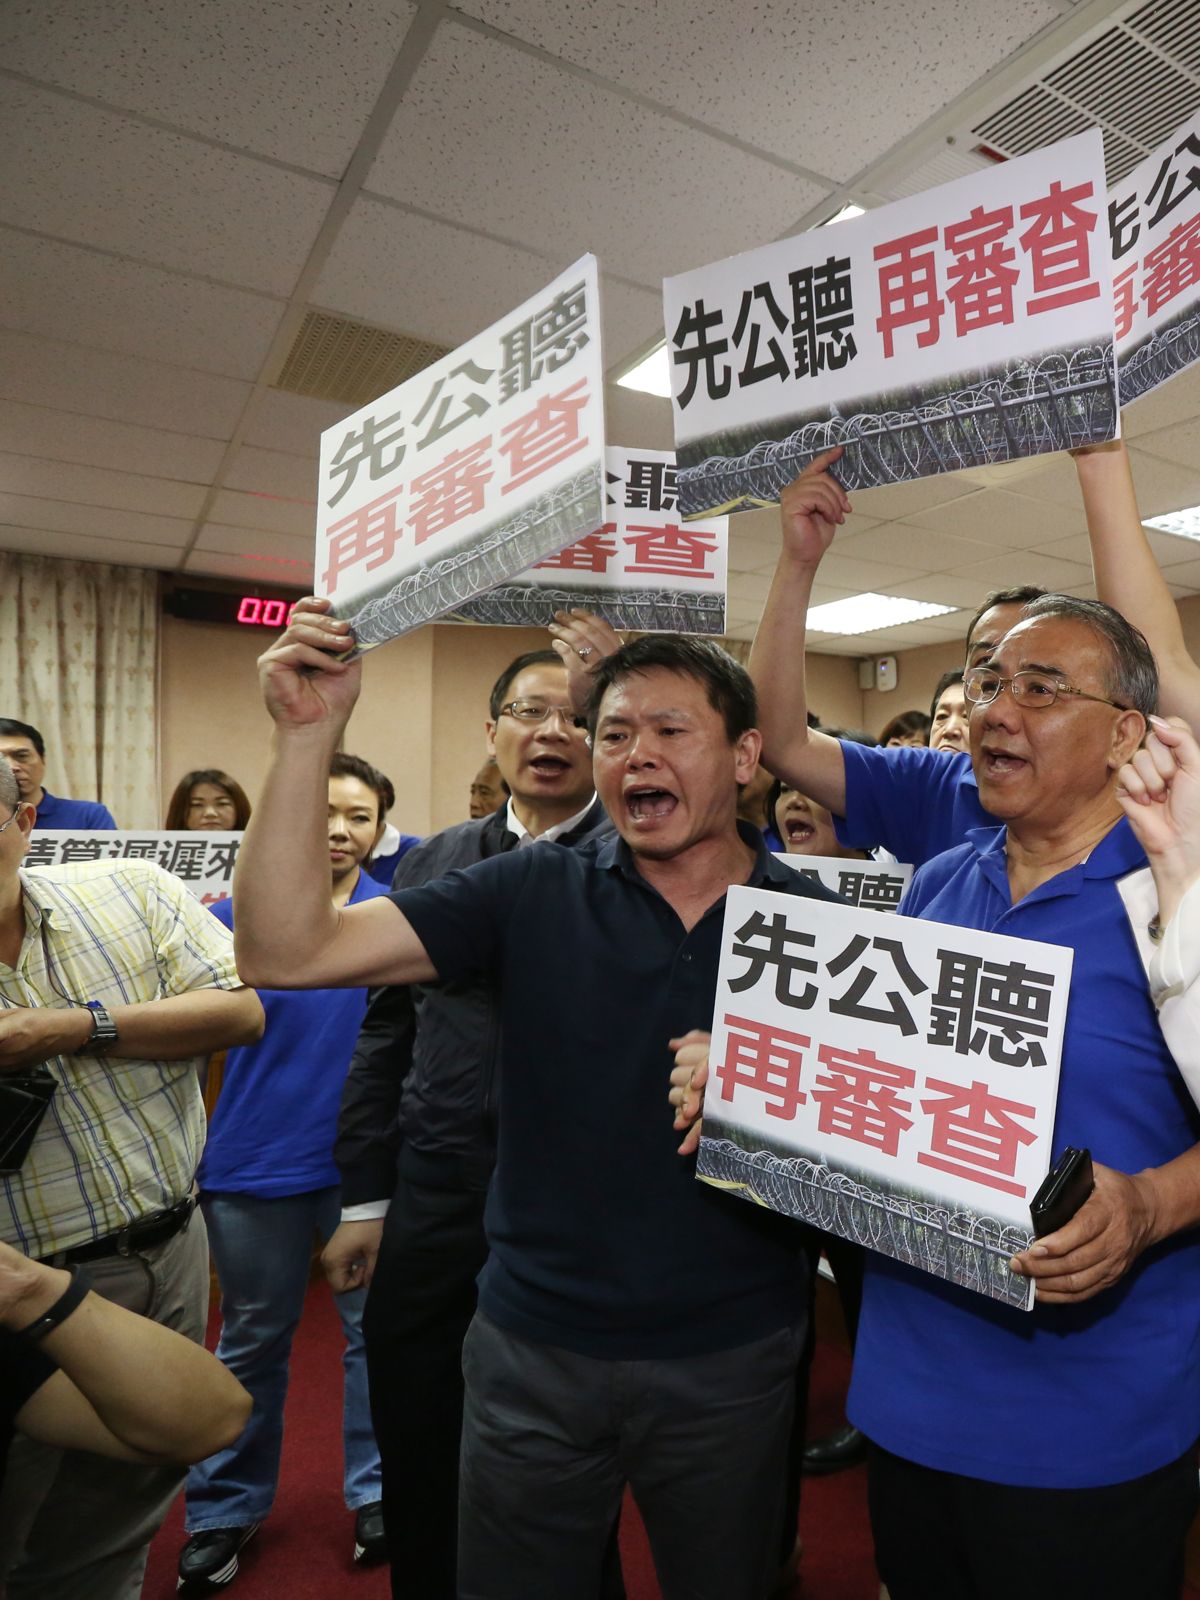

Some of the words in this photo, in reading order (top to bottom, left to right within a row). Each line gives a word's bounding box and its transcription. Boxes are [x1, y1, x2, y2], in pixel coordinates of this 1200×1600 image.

[328, 279, 590, 509] 先公聽
[672, 255, 858, 410] 先公聽
[873, 180, 1101, 359] 再審查
[321, 376, 592, 596] 再審查
[727, 910, 1055, 1068] 先公聽
[716, 1013, 1039, 1199] 再審查
